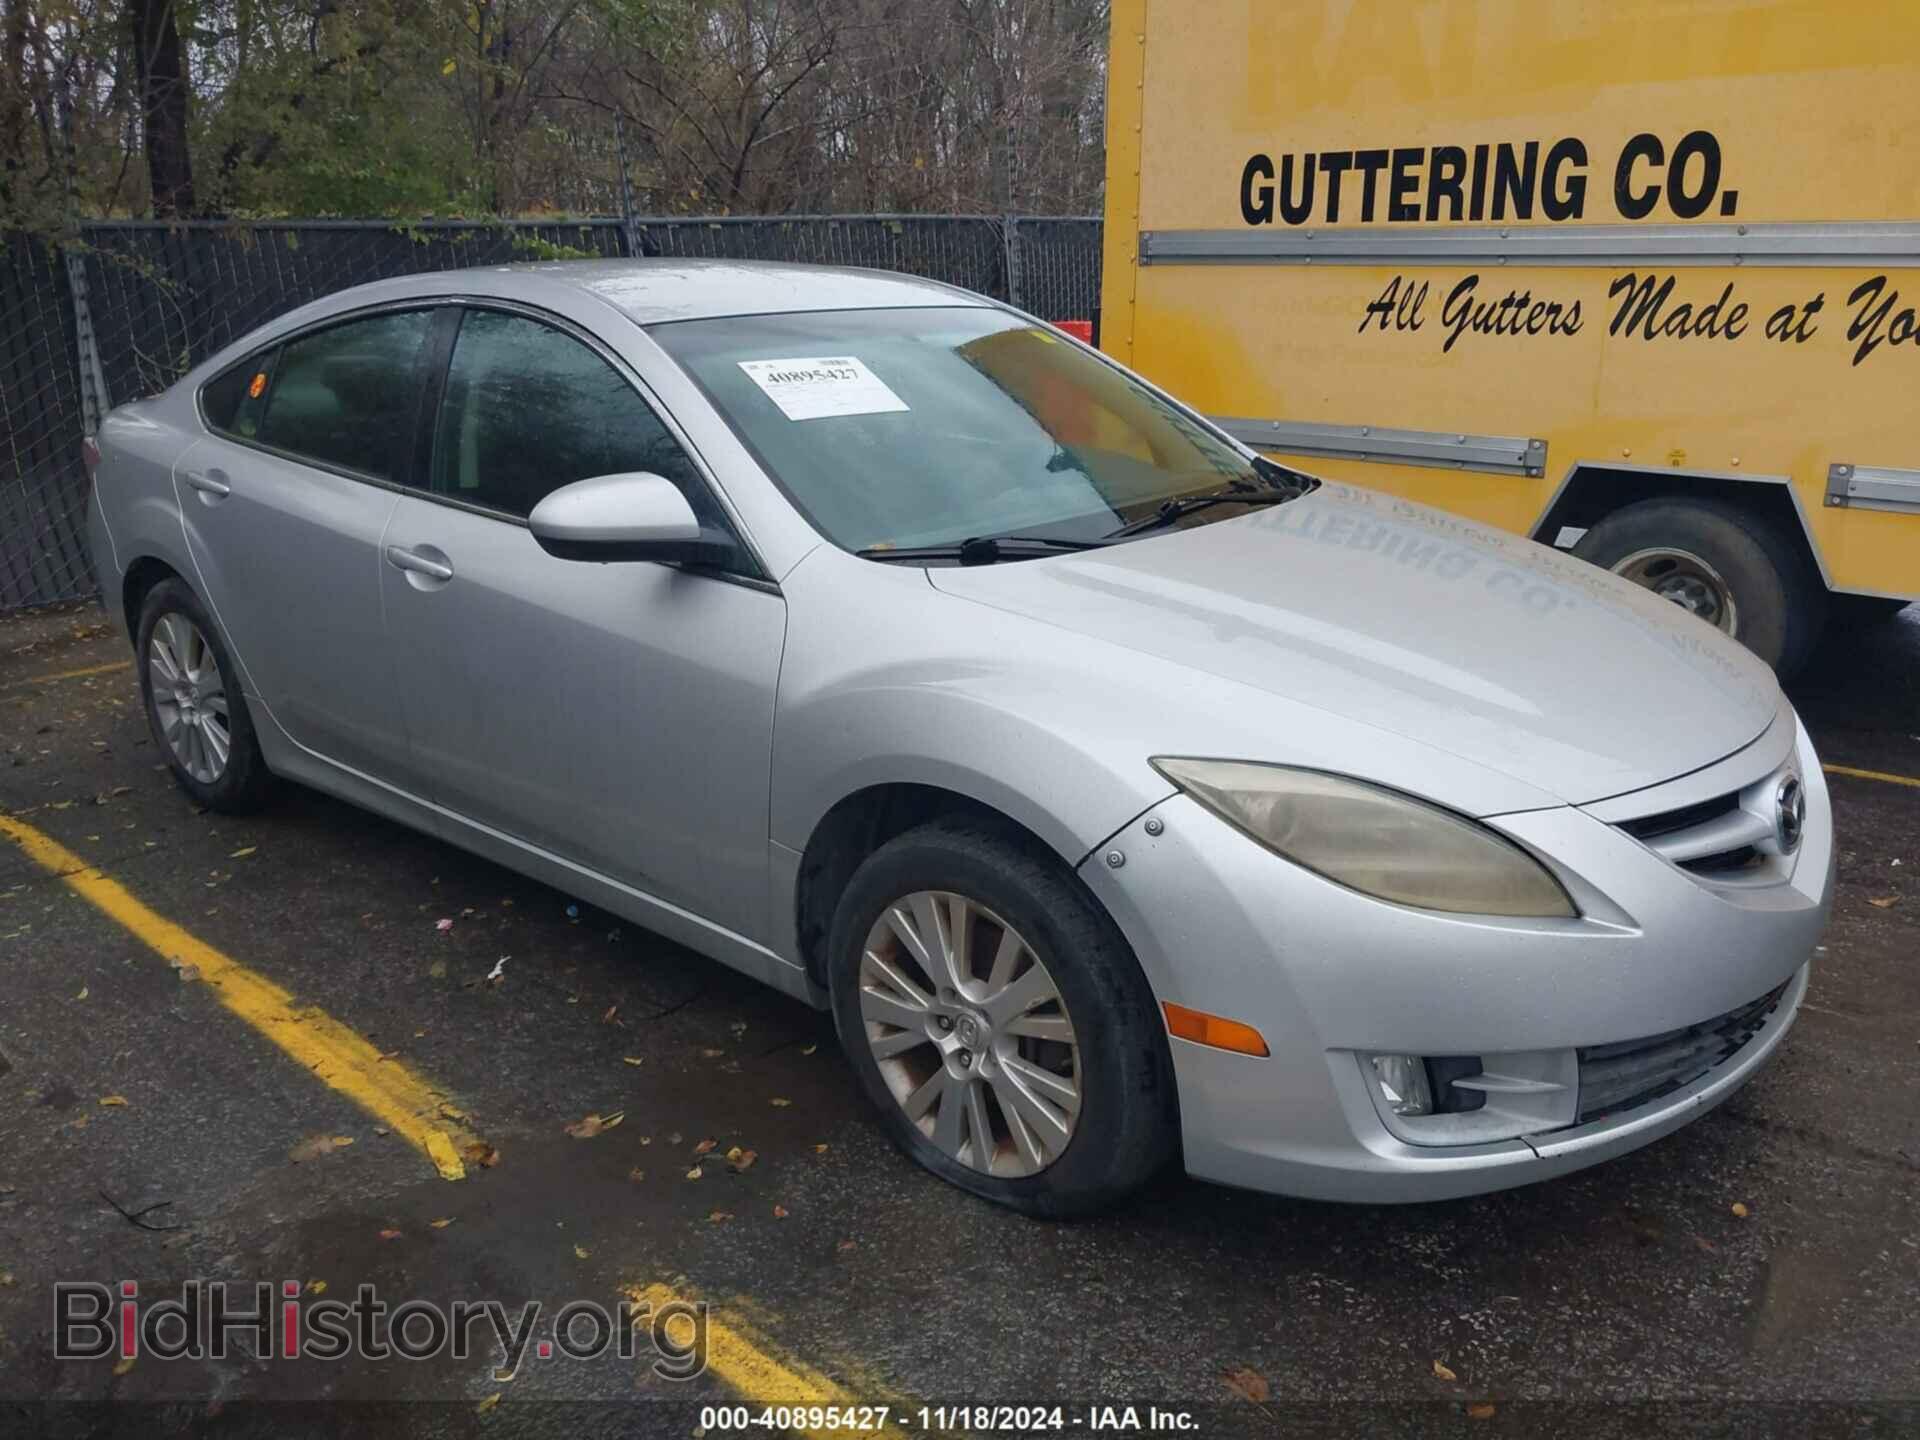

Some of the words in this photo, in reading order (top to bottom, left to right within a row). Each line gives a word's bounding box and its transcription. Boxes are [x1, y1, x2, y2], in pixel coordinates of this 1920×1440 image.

[1240, 137, 1589, 226] GUTTERING
[1613, 130, 1739, 220] CO.
[1357, 275, 1429, 334] All
[1441, 272, 1585, 354] Gutters
[1608, 272, 1749, 341] Made
[1765, 292, 1825, 344] at
[767, 368, 859, 384] 40895427
